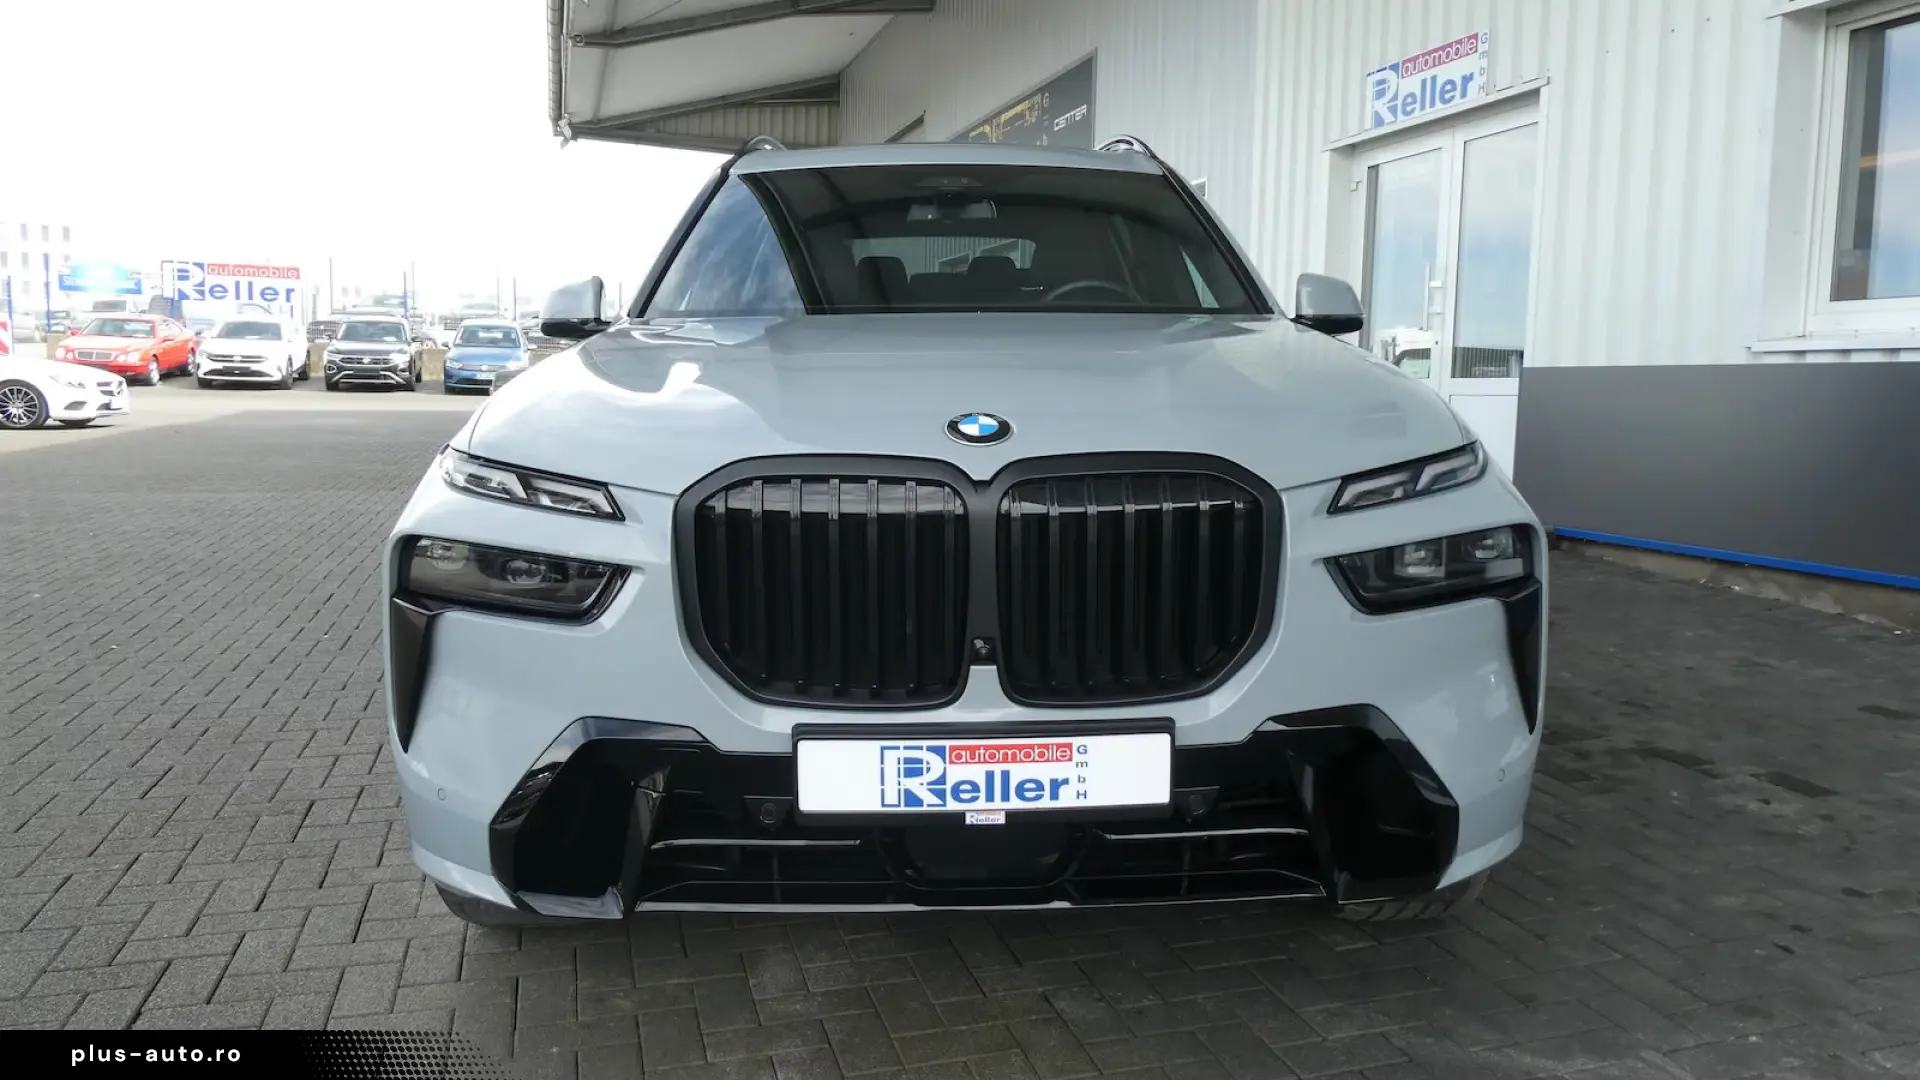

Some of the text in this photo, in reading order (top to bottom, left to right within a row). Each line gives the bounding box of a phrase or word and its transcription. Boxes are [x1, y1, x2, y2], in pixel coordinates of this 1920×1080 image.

[1402, 37, 1476, 77] automobile
[1366, 64, 1474, 128] Reller
[161, 260, 295, 302] Reller
[208, 264, 299, 278] automobile
[952, 744, 1070, 762] automobile
[881, 746, 1070, 807] Reller
